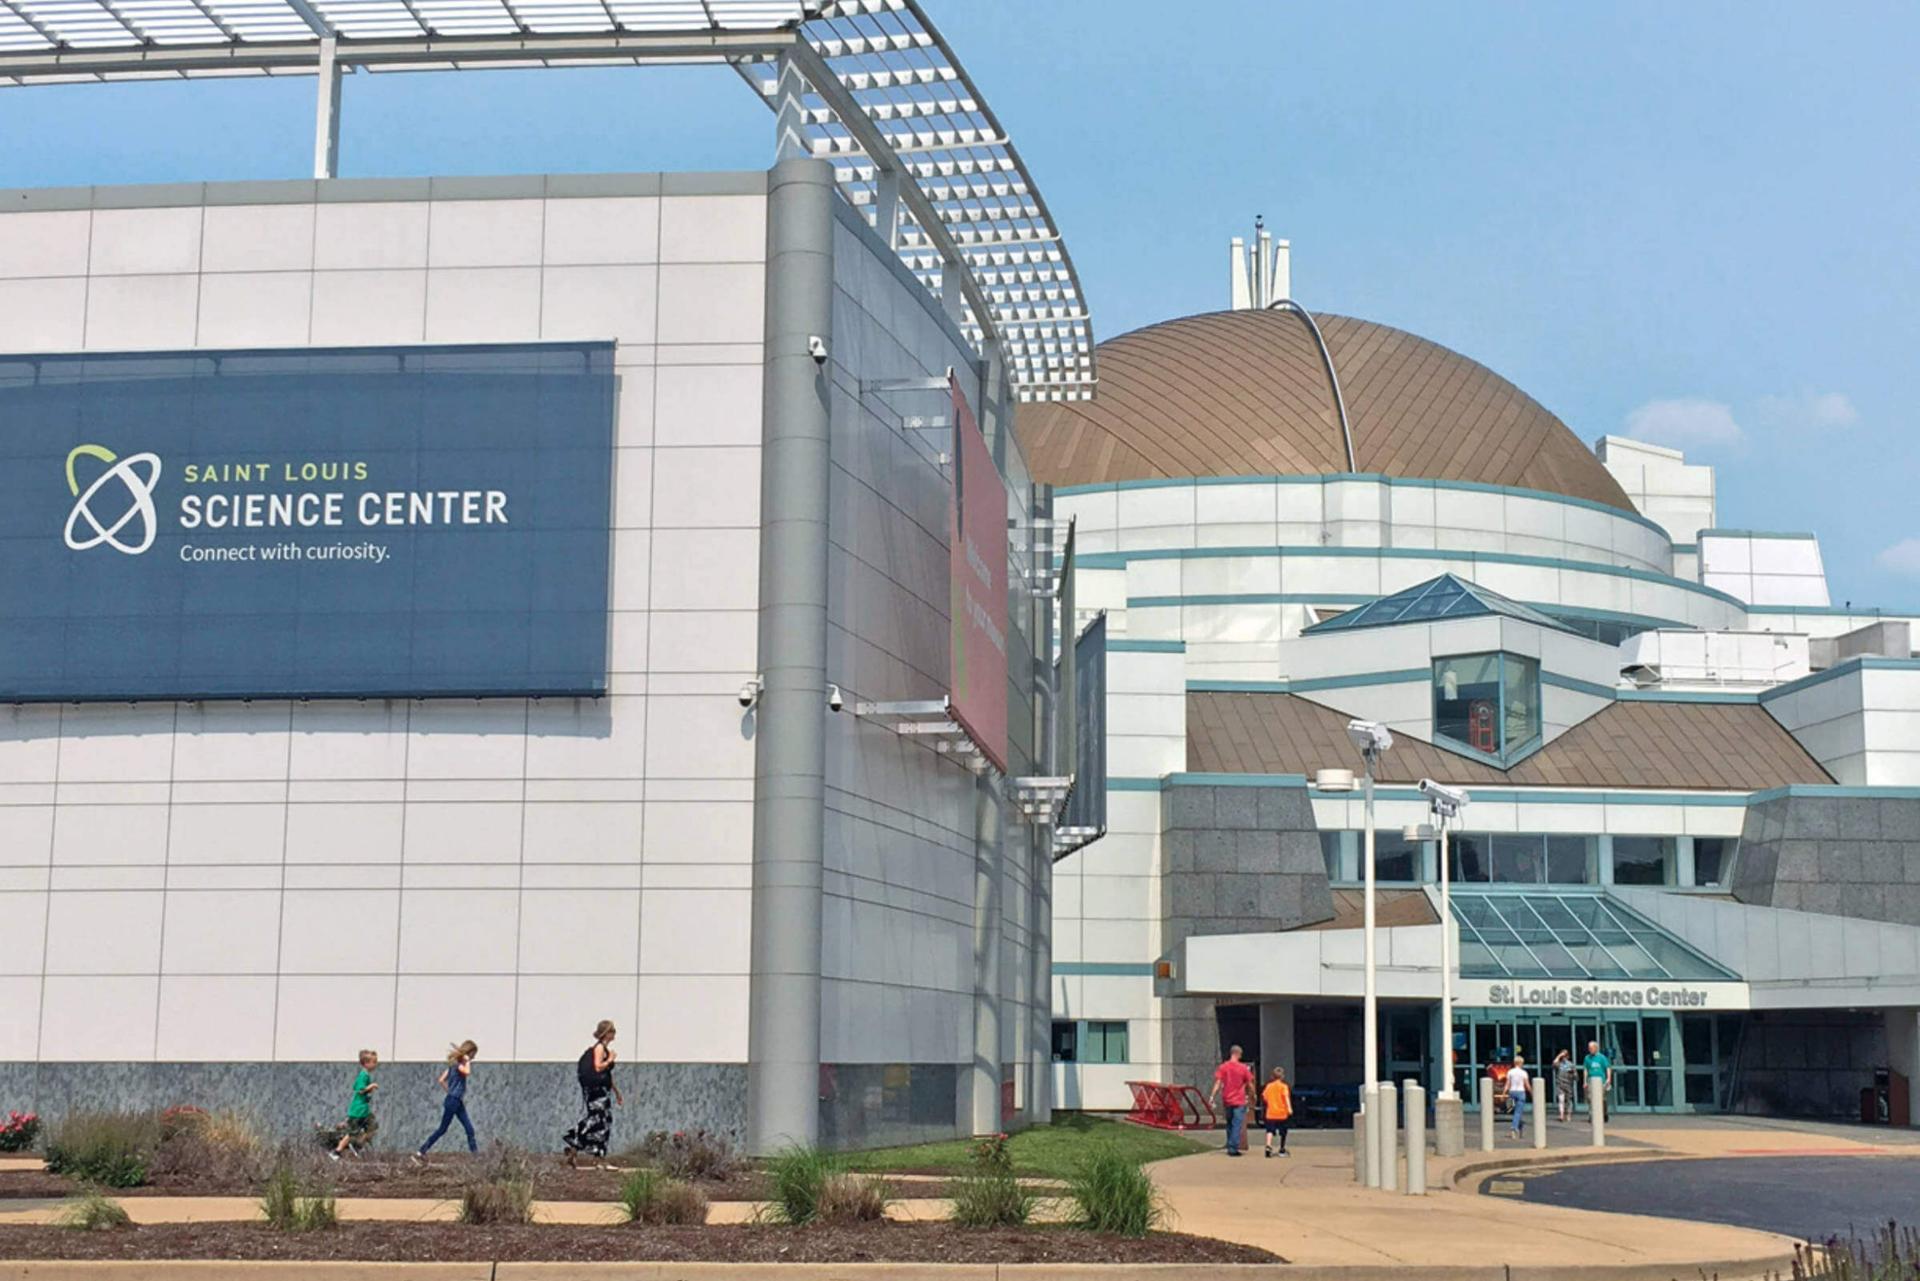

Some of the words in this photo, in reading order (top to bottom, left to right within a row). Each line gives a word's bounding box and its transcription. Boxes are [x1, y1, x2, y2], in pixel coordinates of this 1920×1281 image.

[184, 463, 270, 482] SAINT
[285, 462, 368, 481] LOUIS
[179, 493, 344, 528] SCIENCE
[358, 490, 509, 525] CENTER
[180, 543, 256, 562] Connect
[260, 543, 302, 560] with
[306, 542, 391, 563] curiosity.
[1489, 985, 1515, 1005] St.
[1519, 985, 1567, 1006] Louis
[1570, 986, 1643, 1006] Science
[1646, 987, 1708, 1007] Center
